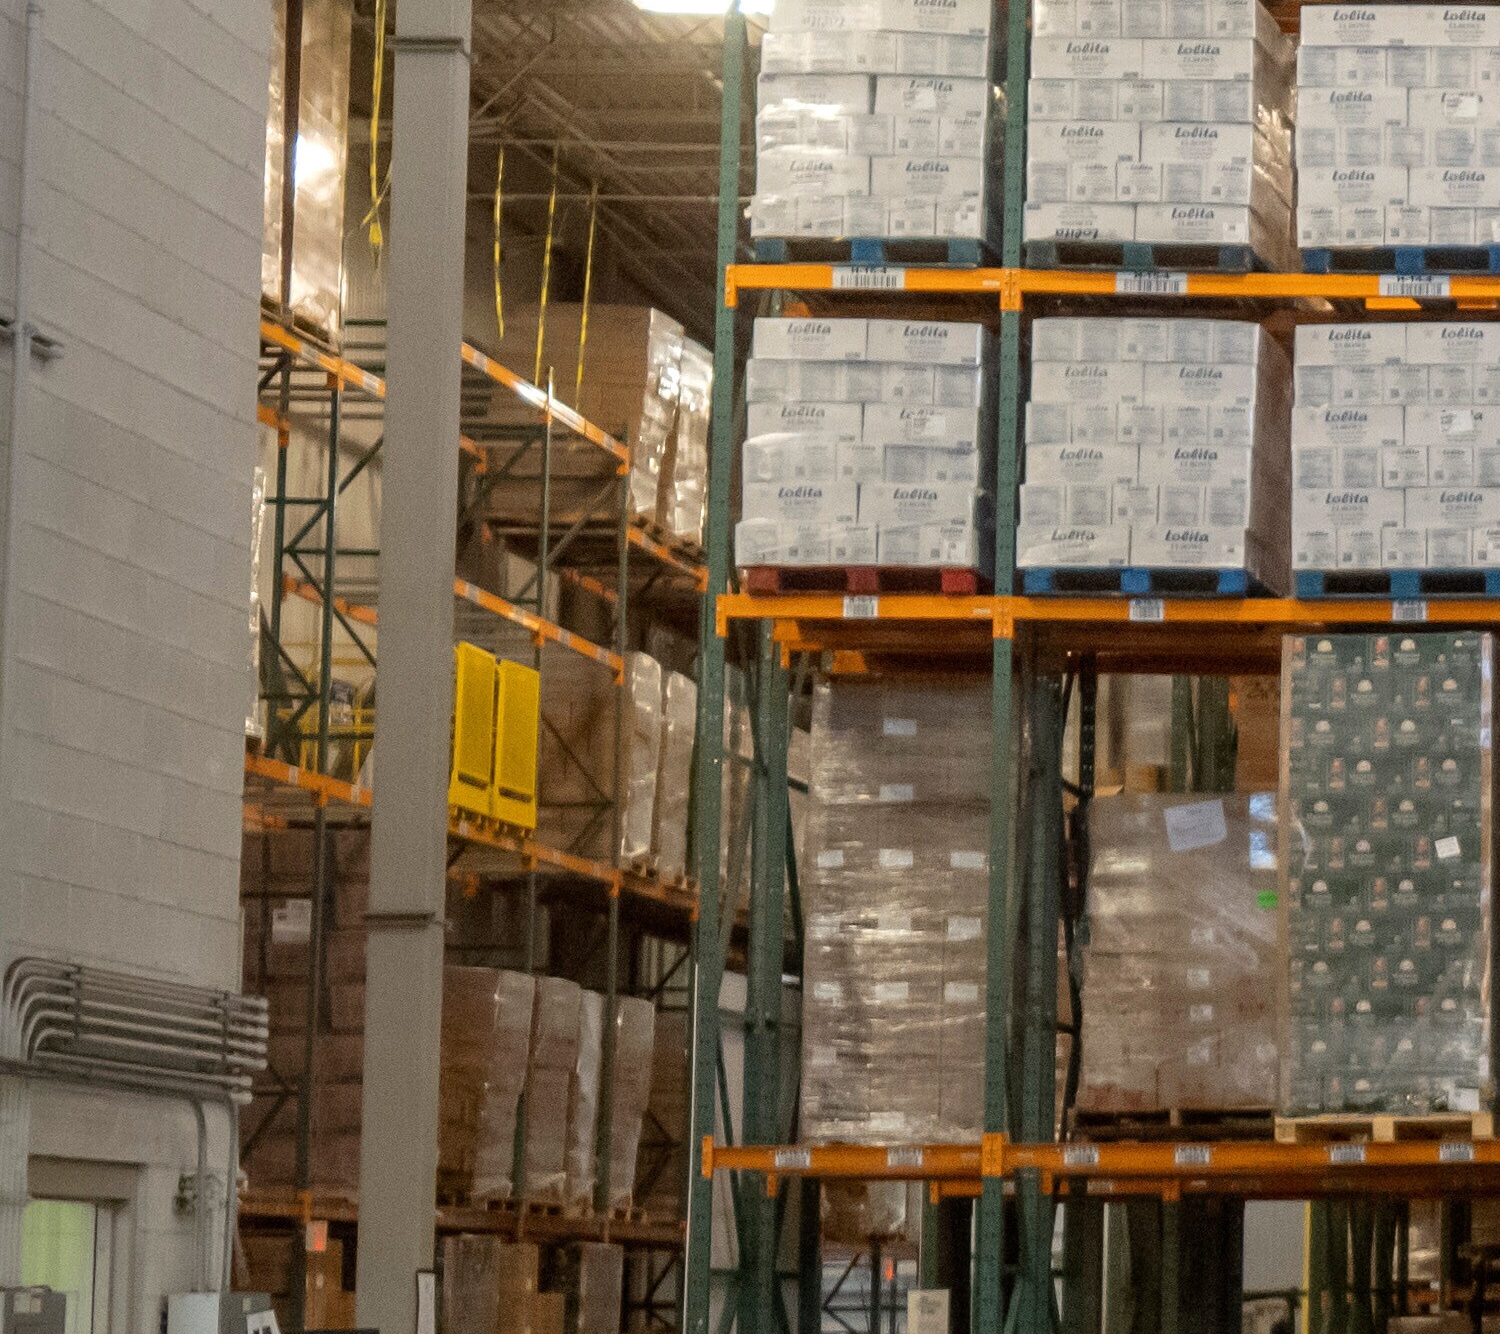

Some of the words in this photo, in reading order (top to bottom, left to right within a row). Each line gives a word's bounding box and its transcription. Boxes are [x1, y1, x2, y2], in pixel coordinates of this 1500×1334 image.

[1334, 9, 1375, 23] Lolita
[1443, 9, 1487, 24] Lolita
[1066, 41, 1110, 56] Lolita
[1177, 43, 1221, 58] Lolita
[1330, 91, 1371, 105] Lolita
[1061, 125, 1105, 140] Lolita
[1175, 126, 1219, 141] Lolita
[906, 160, 950, 175] Lolita
[1332, 169, 1376, 184] Lolita
[1443, 170, 1484, 184] Lolita
[1171, 207, 1215, 222] Lolita
[904, 325, 948, 340] Lolita
[1328, 328, 1372, 343] Lolita
[1441, 326, 1485, 341] Lolita
[1064, 365, 1108, 380] Lolita
[1179, 366, 1223, 381] Lolita
[781, 405, 825, 420] Lolita
[1324, 410, 1368, 425] Lolita
[1060, 448, 1104, 463] Lolita
[1174, 448, 1218, 463] Lolita
[778, 486, 822, 501] Lolita
[894, 488, 938, 503] Lolita
[1325, 492, 1369, 507] Lolita
[1440, 490, 1484, 505] Lolita
[1165, 530, 1209, 545] Lolita
